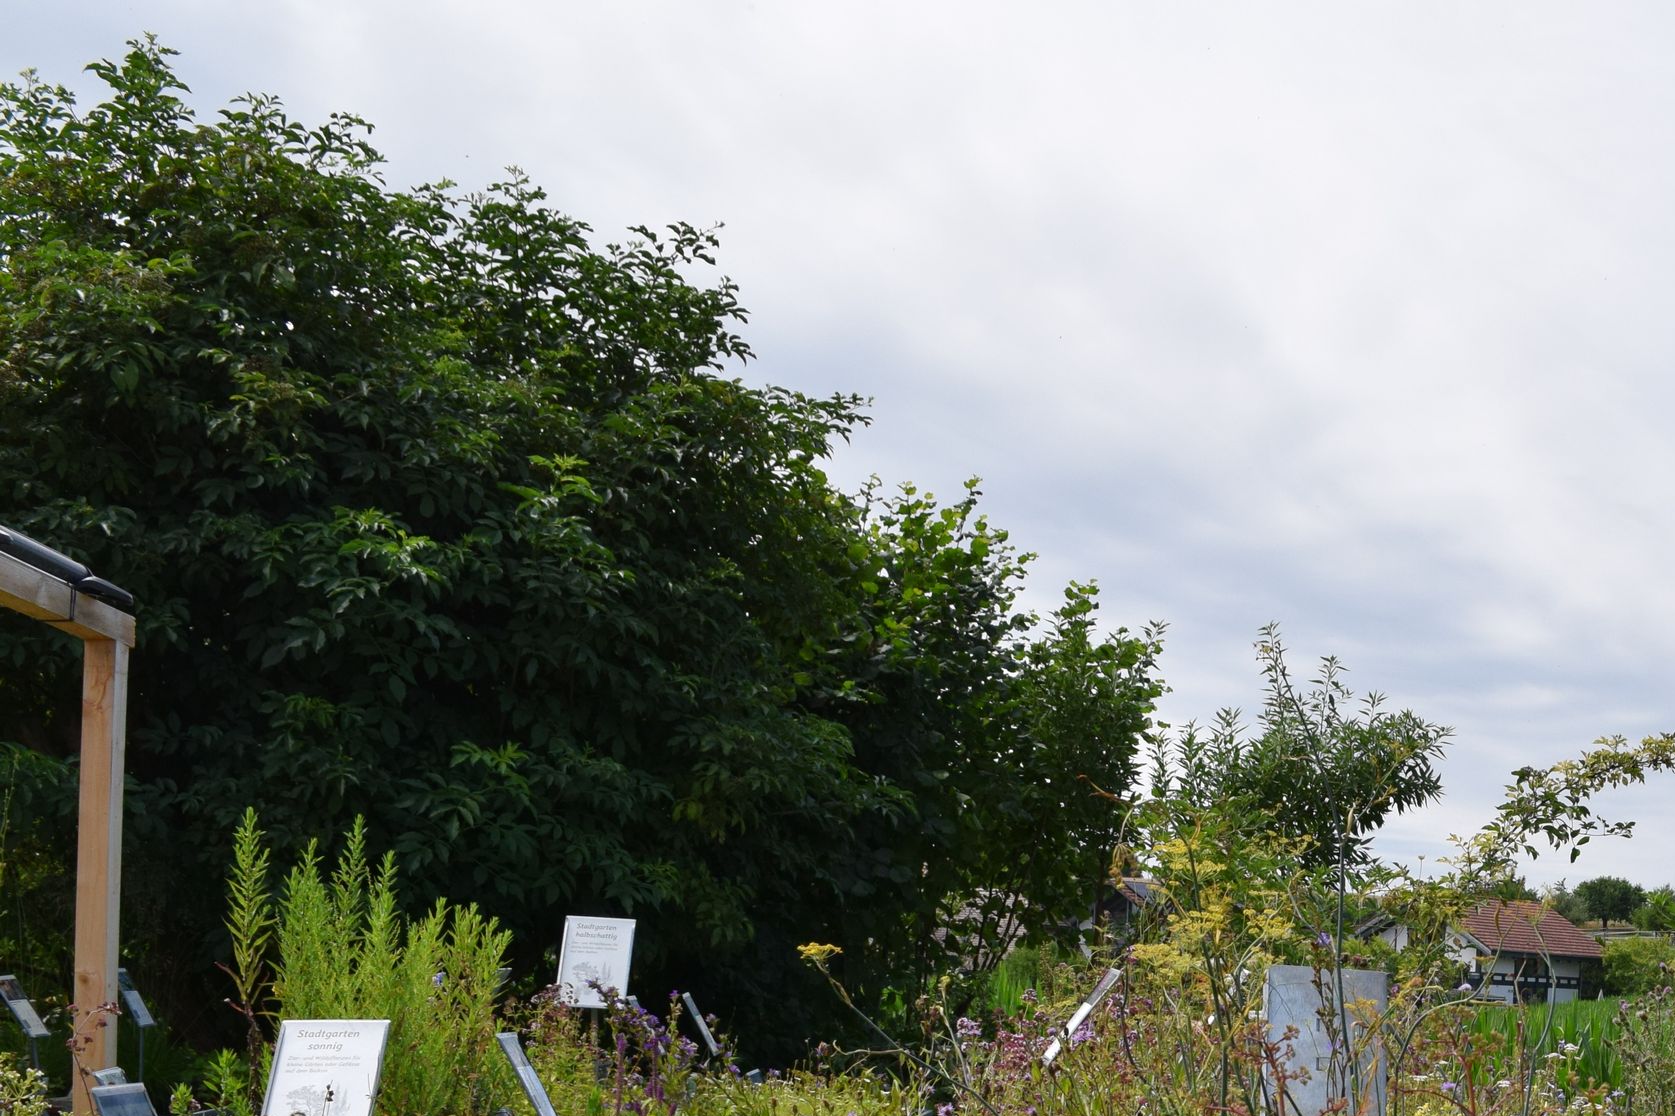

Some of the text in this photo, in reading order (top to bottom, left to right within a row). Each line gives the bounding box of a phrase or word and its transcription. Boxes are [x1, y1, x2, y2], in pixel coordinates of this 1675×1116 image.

[576, 923, 617, 931] Stadtgarten
[575, 931, 618, 941] halbschattig
[297, 1029, 360, 1039] Stadtgarten
[307, 1042, 343, 1052] sonnig
